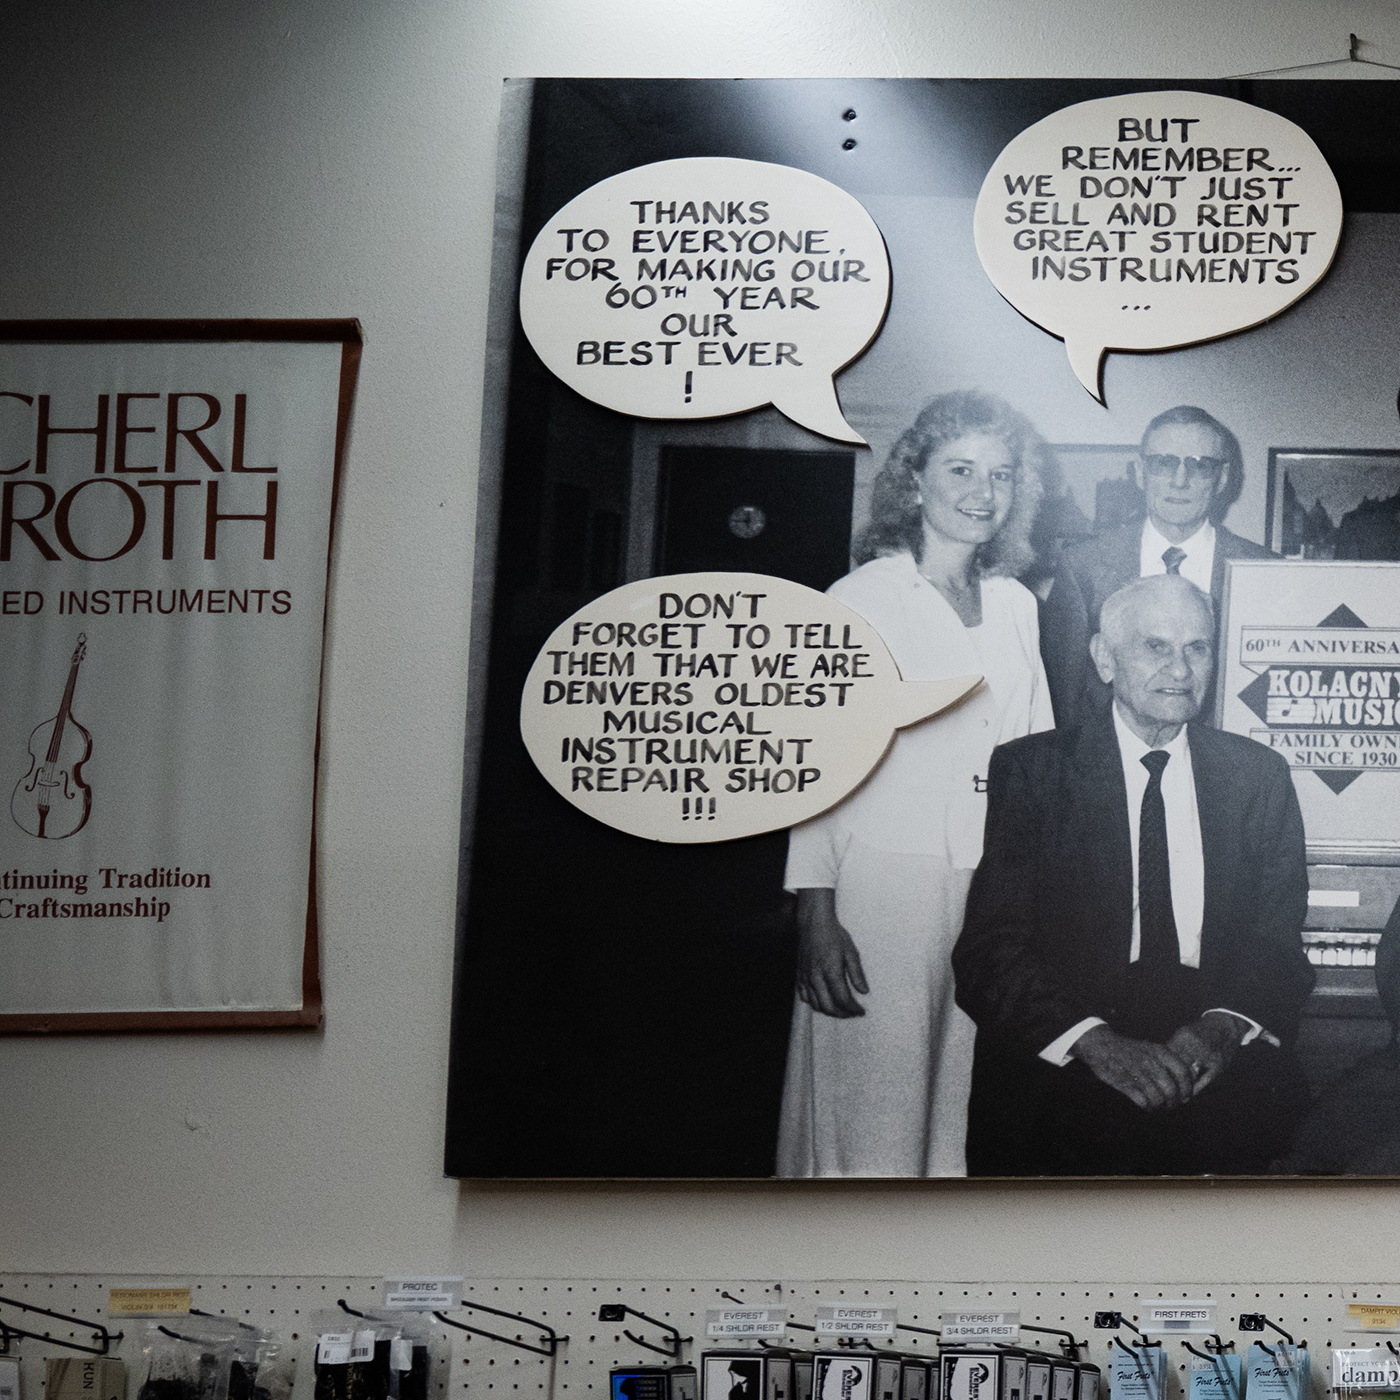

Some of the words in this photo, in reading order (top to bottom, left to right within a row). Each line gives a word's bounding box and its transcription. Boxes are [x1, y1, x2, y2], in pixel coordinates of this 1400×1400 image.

[1117, 118, 1199, 143] BUT
[1062, 146, 1302, 172] REMEMBER...
[1004, 174, 1055, 198] WE
[1080, 174, 1185, 200] DON'T
[1201, 176, 1293, 201] JUST
[630, 200, 770, 225] THANKS
[1004, 202, 1091, 226] SELL
[1107, 202, 1177, 227] AND
[1197, 202, 1298, 227] RENT
[556, 229, 610, 253] TO
[1013, 230, 1136, 254] GREAT
[1150, 231, 1316, 256] STUDENT
[546, 258, 620, 282] FOR
[637, 258, 776, 282] MAKING
[796, 258, 870, 282] OUR
[1031, 258, 1301, 284] INSTRUMENTS
[605, 284, 688, 309] 60TH
[714, 286, 819, 311] YEAR
[661, 313, 738, 337] OUR
[577, 341, 681, 366] BEST
[700, 342, 803, 367] EVER
[60, 589, 292, 615] INSTRUMENTS
[659, 591, 767, 619] DON'T
[573, 621, 706, 649] FORGET
[726, 623, 770, 649] TO
[784, 623, 863, 649] TELL
[1246, 638, 1281, 653] 60TH
[546, 651, 635, 677] THEM
[653, 652, 738, 678] THAT
[752, 653, 798, 679] WE
[811, 653, 874, 678] ARE
[543, 680, 693, 706] DENVERS
[715, 683, 854, 708] OLDEST
[603, 710, 771, 735] MUSICAL
[562, 737, 812, 765] INSTRUMENT
[1269, 733, 1342, 749] FAMILY
[1295, 750, 1354, 766] SINCE
[1361, 751, 1398, 766] 1930
[571, 767, 710, 793] REPAIR
[725, 768, 821, 793] SHOP
[99, 867, 210, 889] Tradition
[723, 1312, 765, 1321] EVEREST
